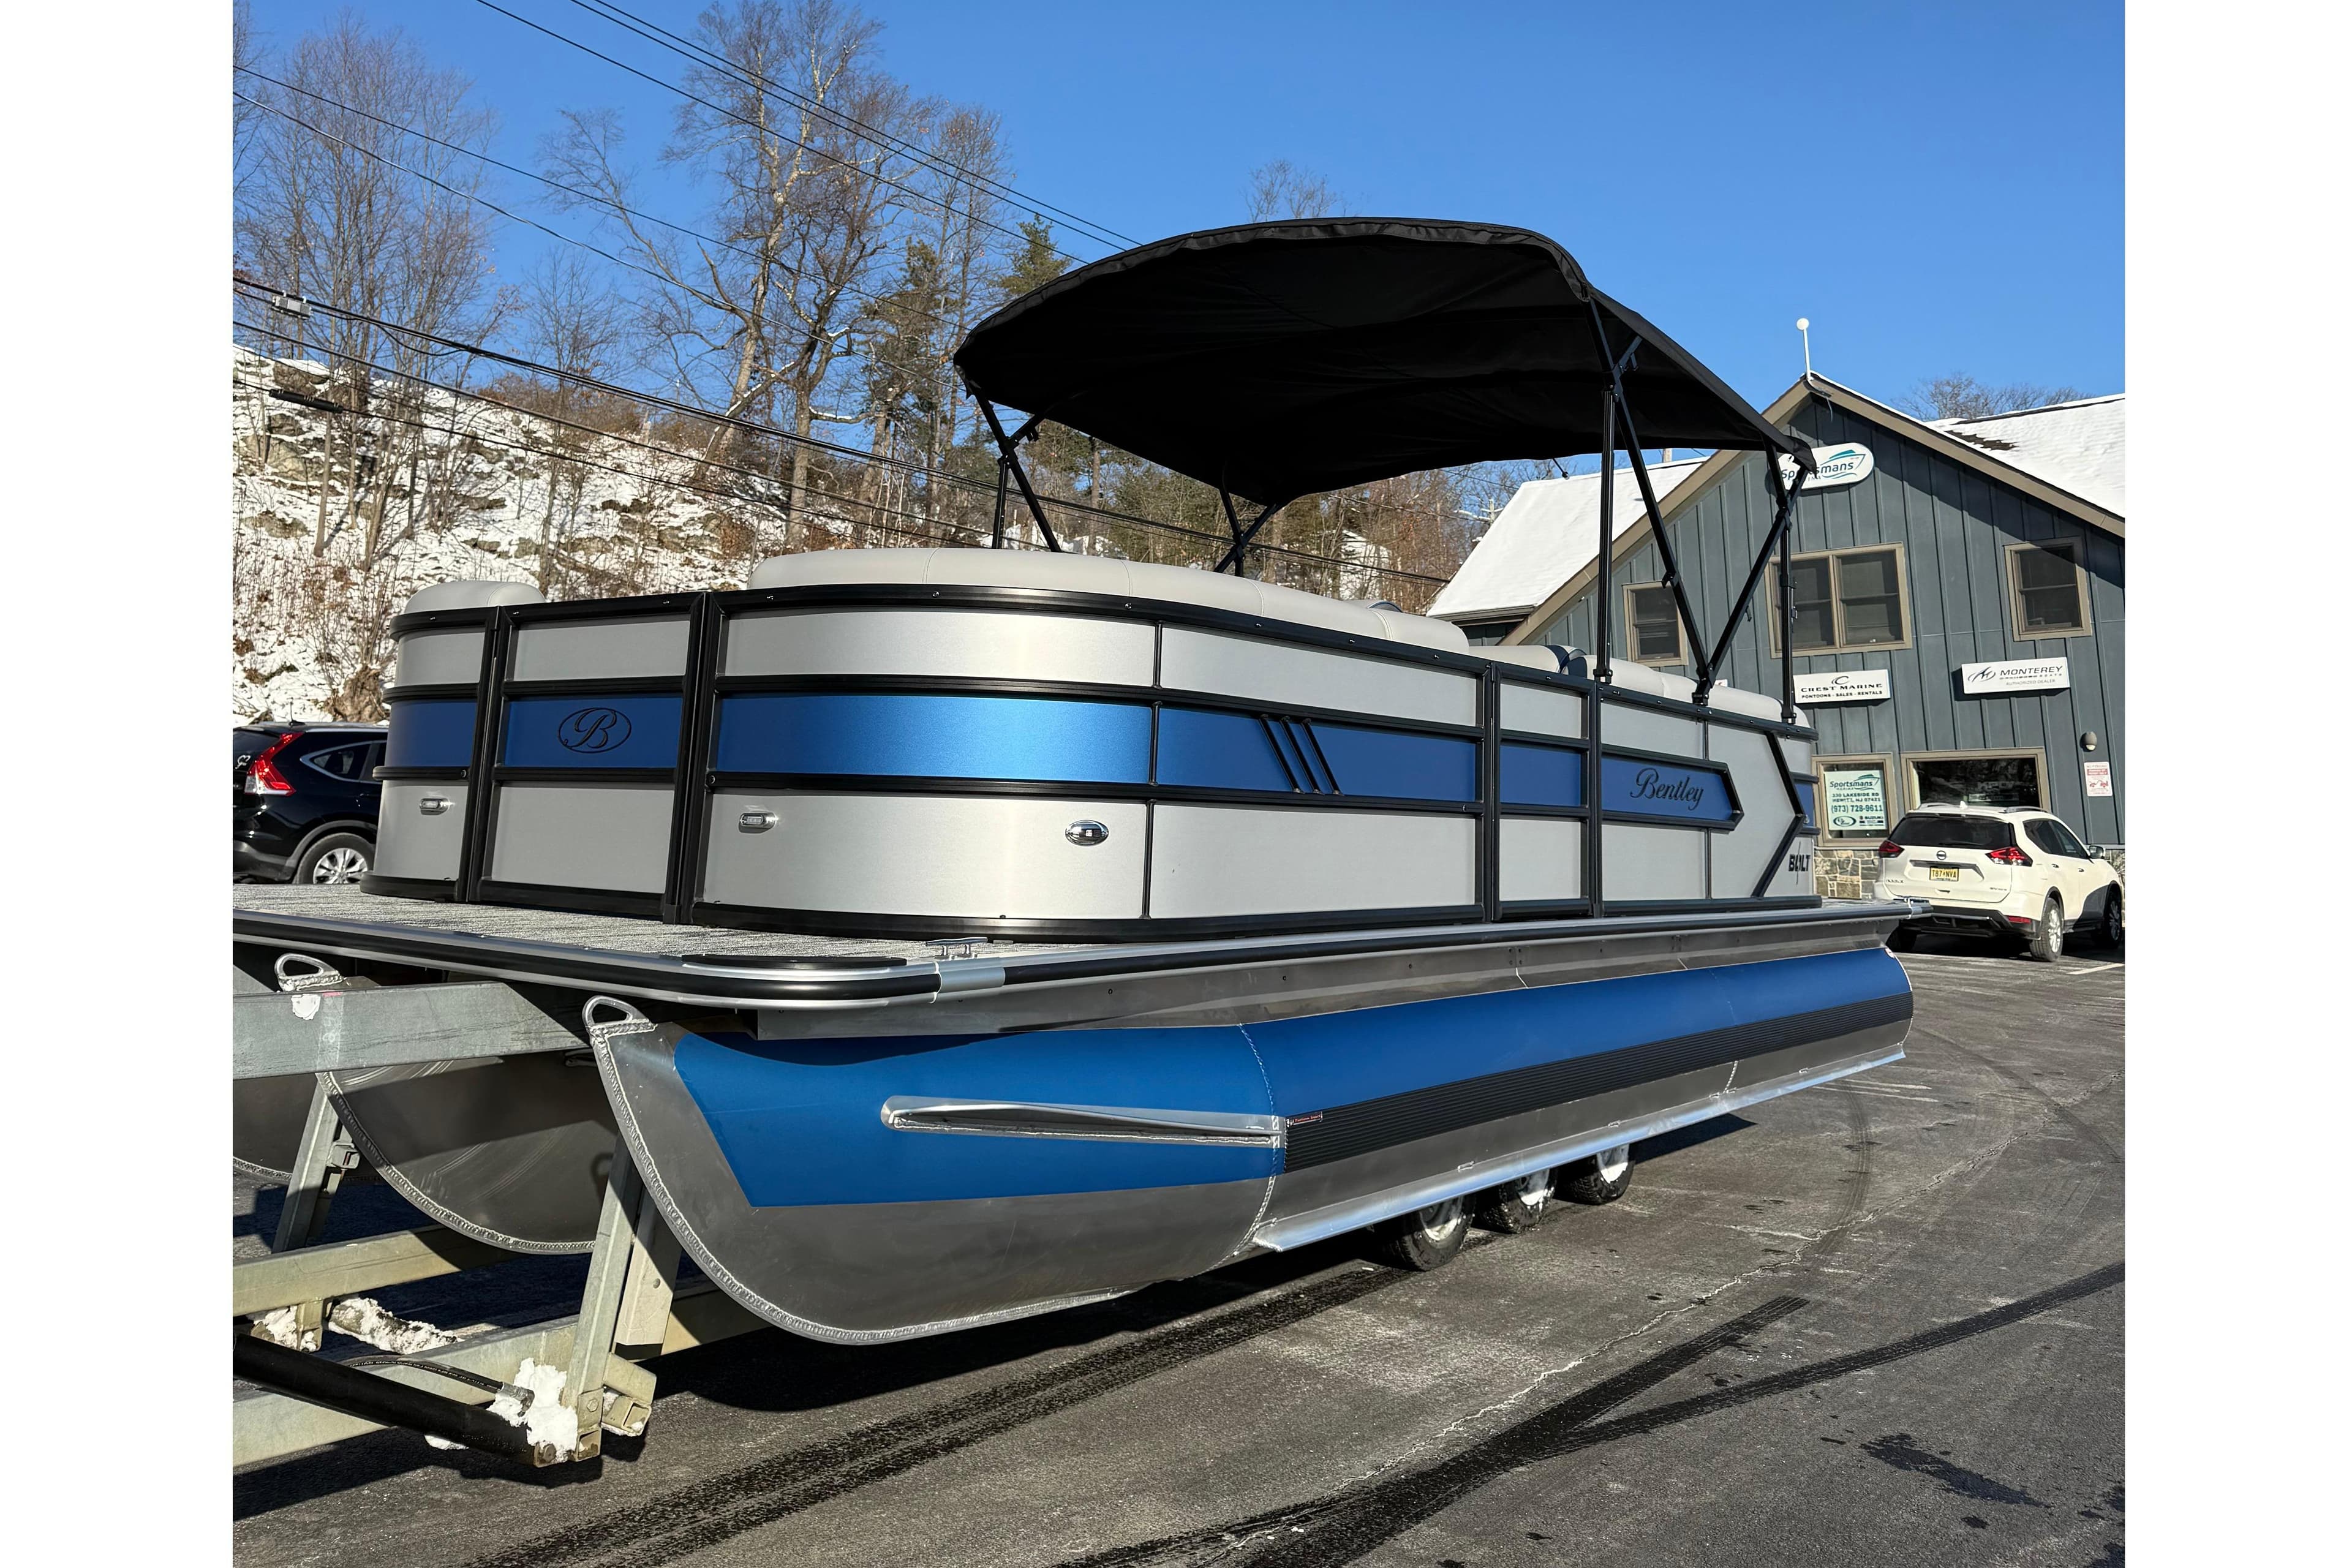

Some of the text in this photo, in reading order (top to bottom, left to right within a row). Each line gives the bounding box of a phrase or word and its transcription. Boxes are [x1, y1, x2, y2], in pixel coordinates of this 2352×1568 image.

[1782, 462, 1854, 480] Spsmans
[2000, 666, 2063, 676] MONTEREY
[1629, 767, 1704, 811] Bentley
[1831, 805, 1849, 813] (973)
